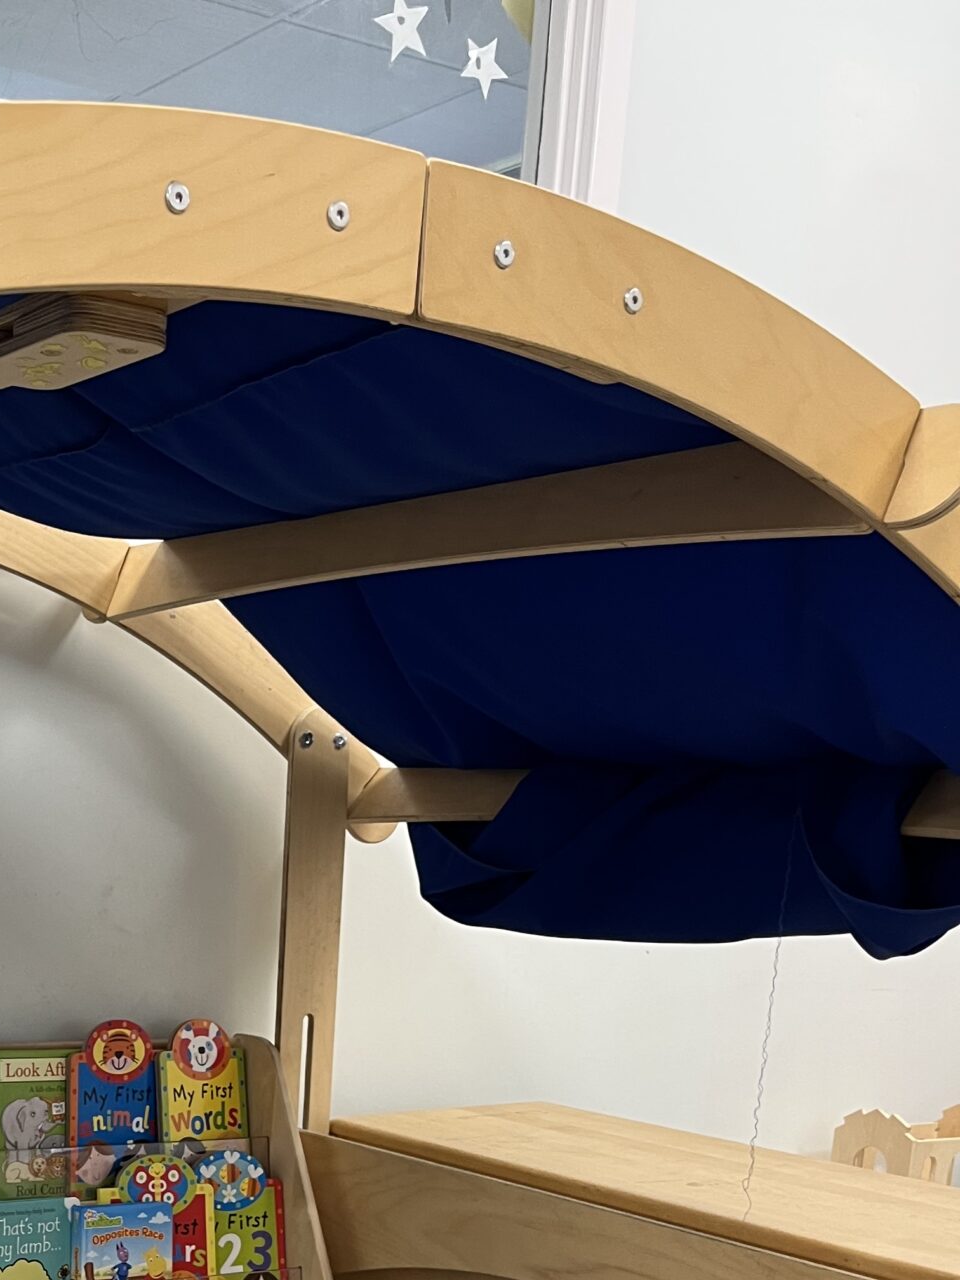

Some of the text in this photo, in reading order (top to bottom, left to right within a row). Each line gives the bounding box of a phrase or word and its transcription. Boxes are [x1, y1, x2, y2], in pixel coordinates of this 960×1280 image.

[6, 1062, 40, 1078] Look
[84, 1087, 108, 1111] My
[115, 1086, 152, 1103] First
[173, 1082, 234, 1107] My First
[16, 1184, 37, 1197] Rod
[37, 1217, 61, 1234] not
[228, 1211, 269, 1230] First
[92, 1226, 165, 1246] Opposites Race
